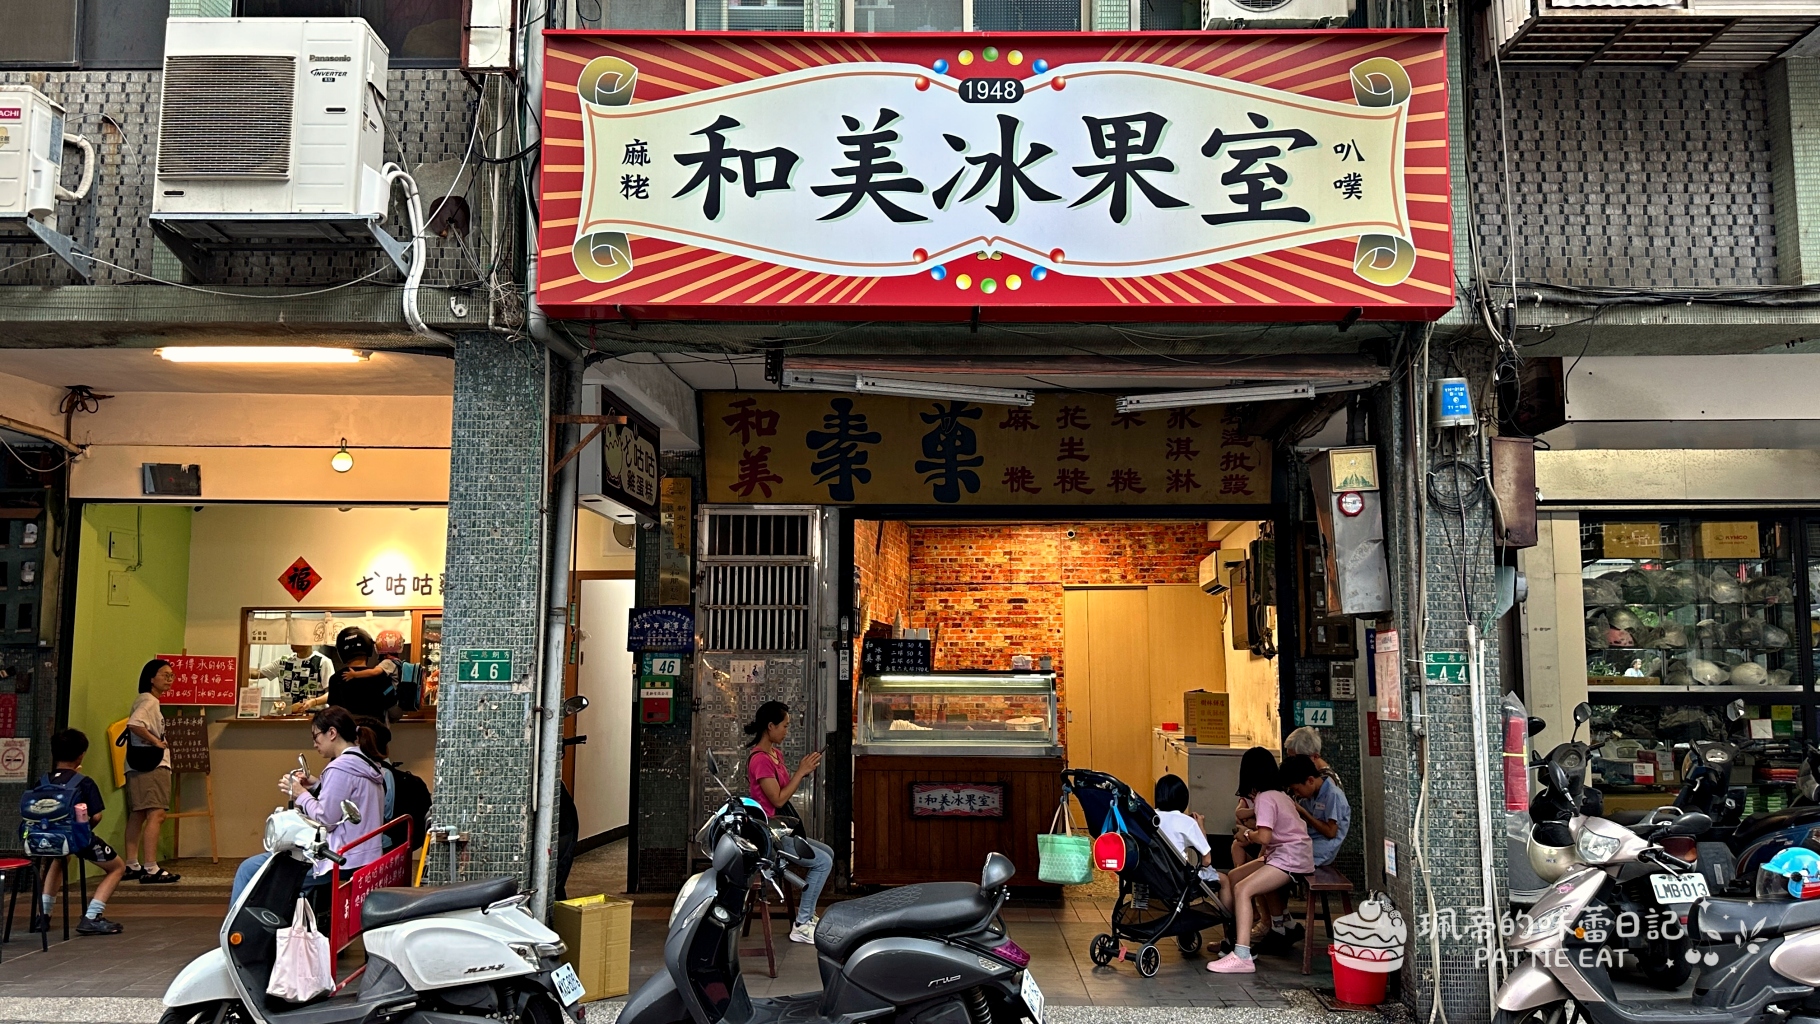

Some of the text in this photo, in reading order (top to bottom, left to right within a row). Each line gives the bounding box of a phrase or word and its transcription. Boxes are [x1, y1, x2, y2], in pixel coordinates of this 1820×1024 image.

[309, 54, 351, 62] Panasonic
[965, 80, 1017, 99] 1948
[619, 138, 651, 201] 麻粩
[671, 108, 1317, 225] 和美冰果室
[1332, 138, 1365, 201] 叭噗
[722, 397, 783, 499] 和美
[1165, 407, 1202, 494] 冰淇淋
[290, 567, 310, 590] 福
[470, 662, 499, 680] 46
[658, 660, 676, 674] 46
[1310, 709, 1327, 724] 44
[924, 793, 991, 807] 和美冰果室
